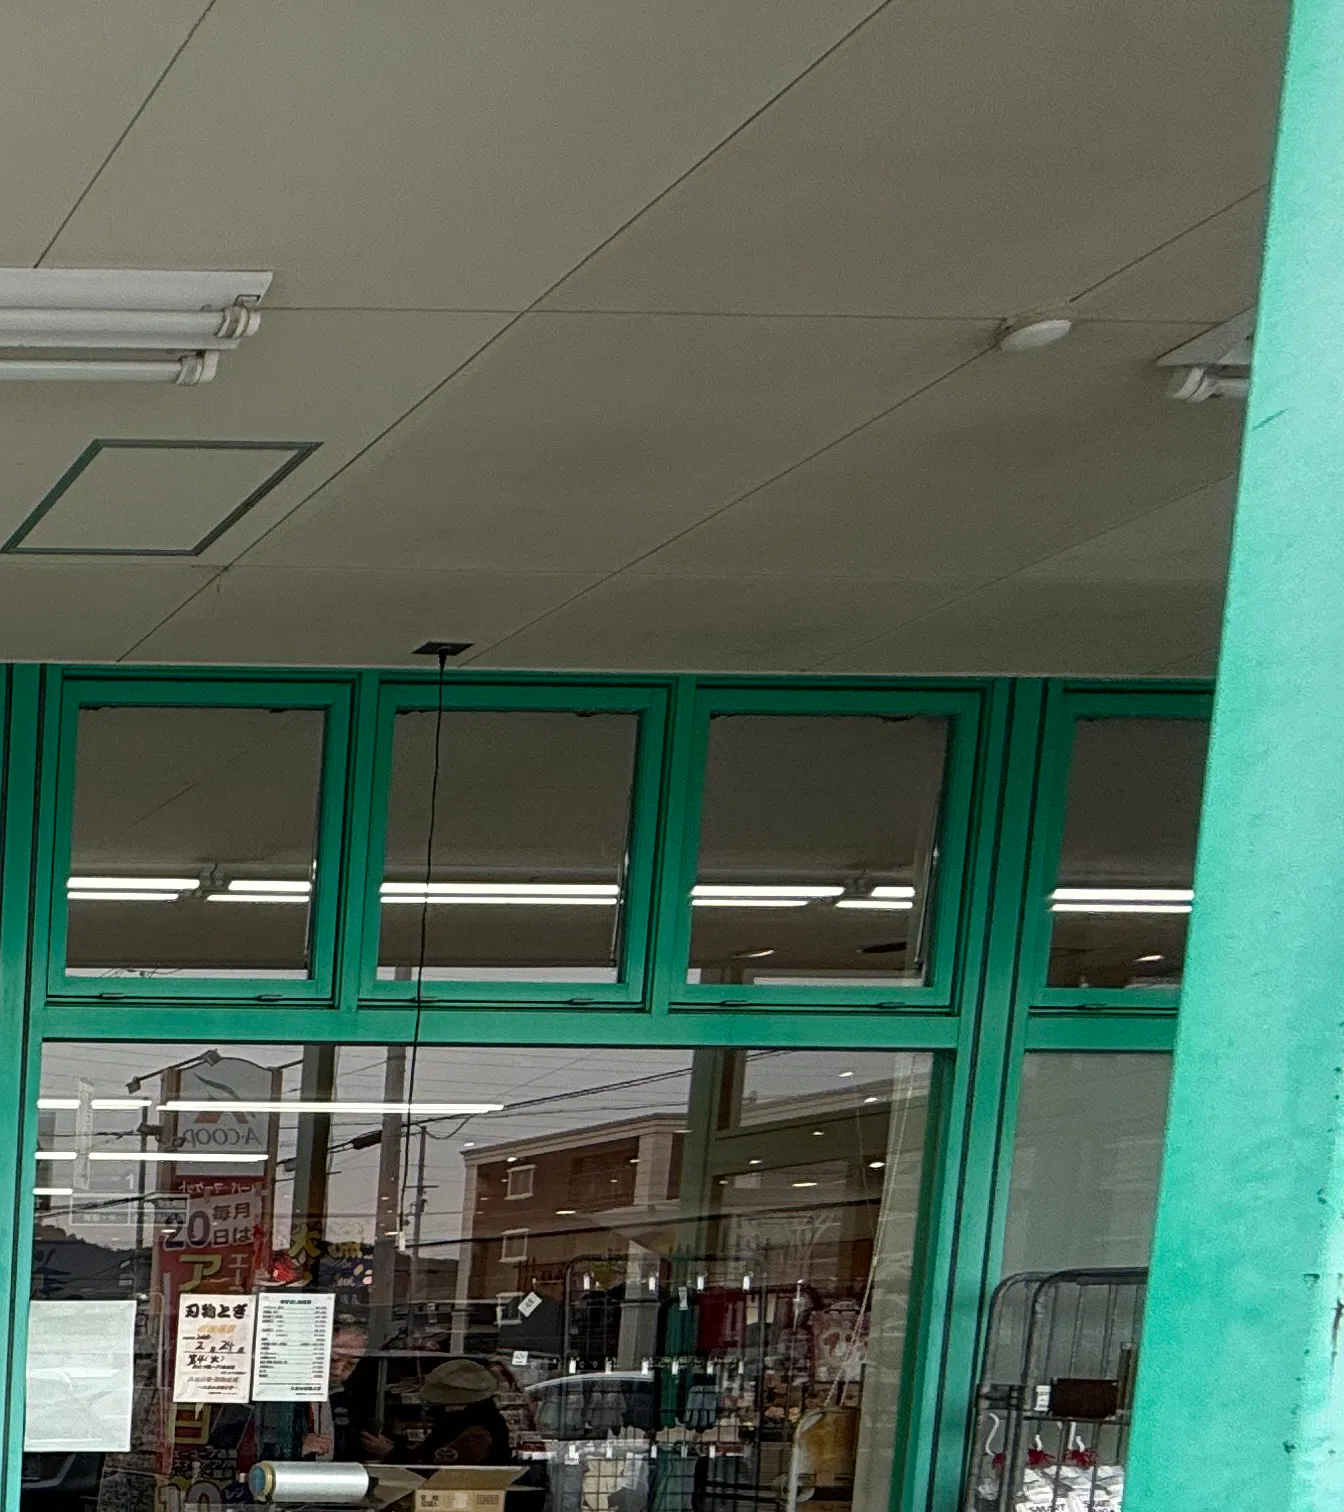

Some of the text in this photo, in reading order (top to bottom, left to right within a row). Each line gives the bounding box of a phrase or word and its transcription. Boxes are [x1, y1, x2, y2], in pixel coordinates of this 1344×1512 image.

[213, 1201, 251, 1222] 毎月
[184, 1302, 249, 1320] 刃物とぎ
